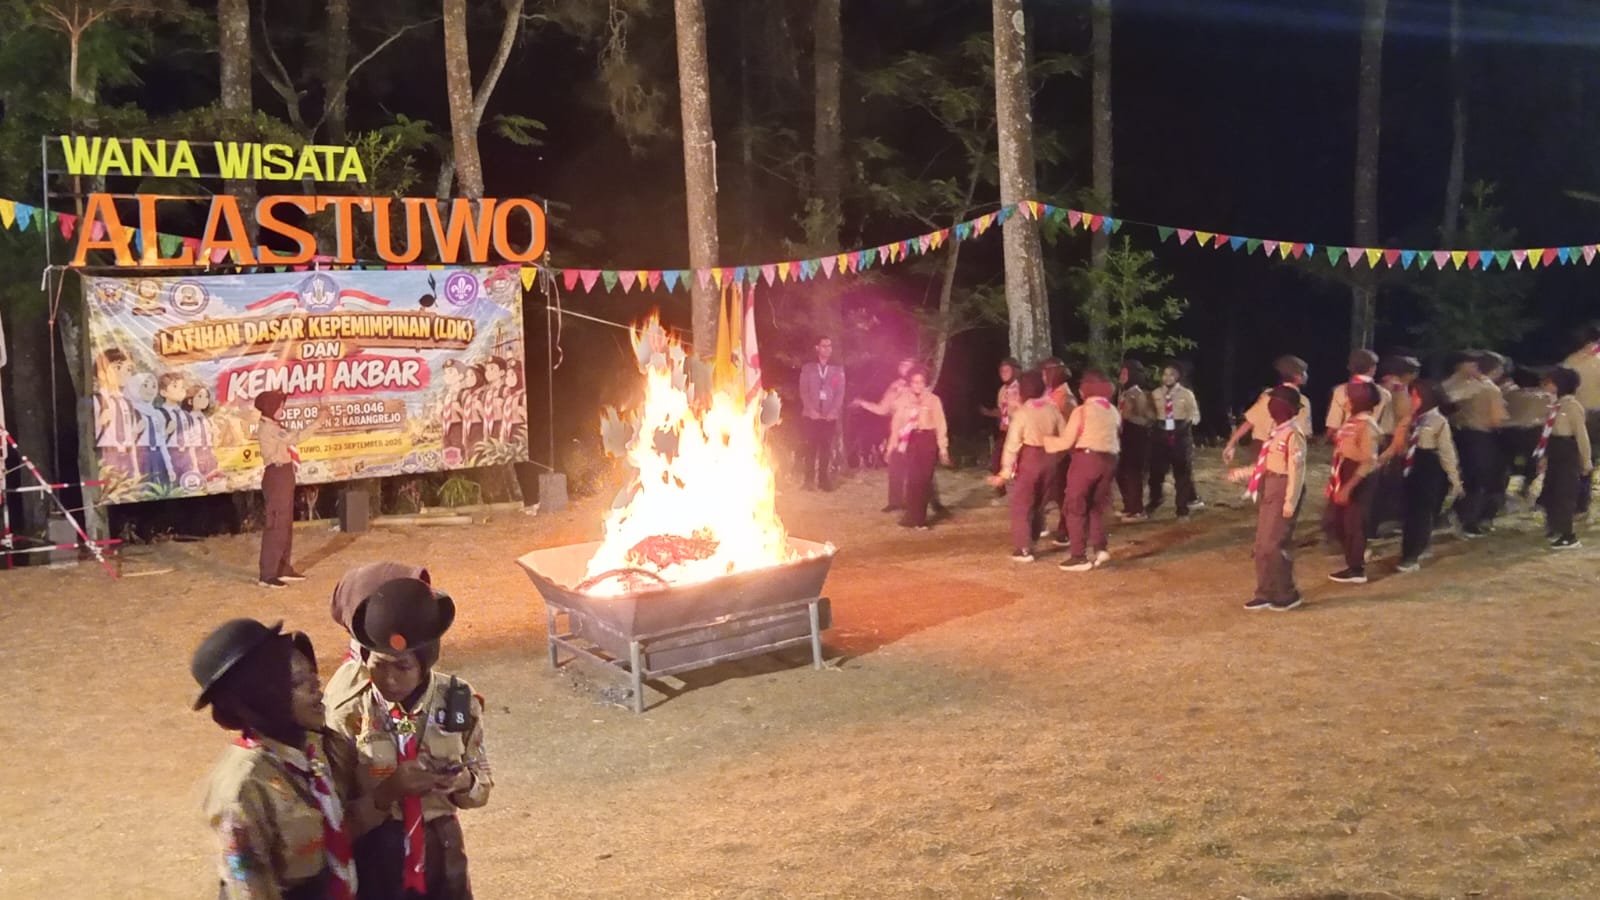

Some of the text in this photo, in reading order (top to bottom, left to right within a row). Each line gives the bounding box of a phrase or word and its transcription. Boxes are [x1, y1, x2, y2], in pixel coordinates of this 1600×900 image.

[61, 135, 366, 183] WANA WISATA
[69, 193, 546, 267] ALASTUWO
[160, 315, 473, 355] LATIHAN DASAR KEPEMIMPINAN (LDK)
[303, 342, 340, 358] DAN
[227, 359, 420, 401] KEMAH AKBAR
[303, 406, 318, 418] 08
[342, 412, 401, 427] KARANGREJO
